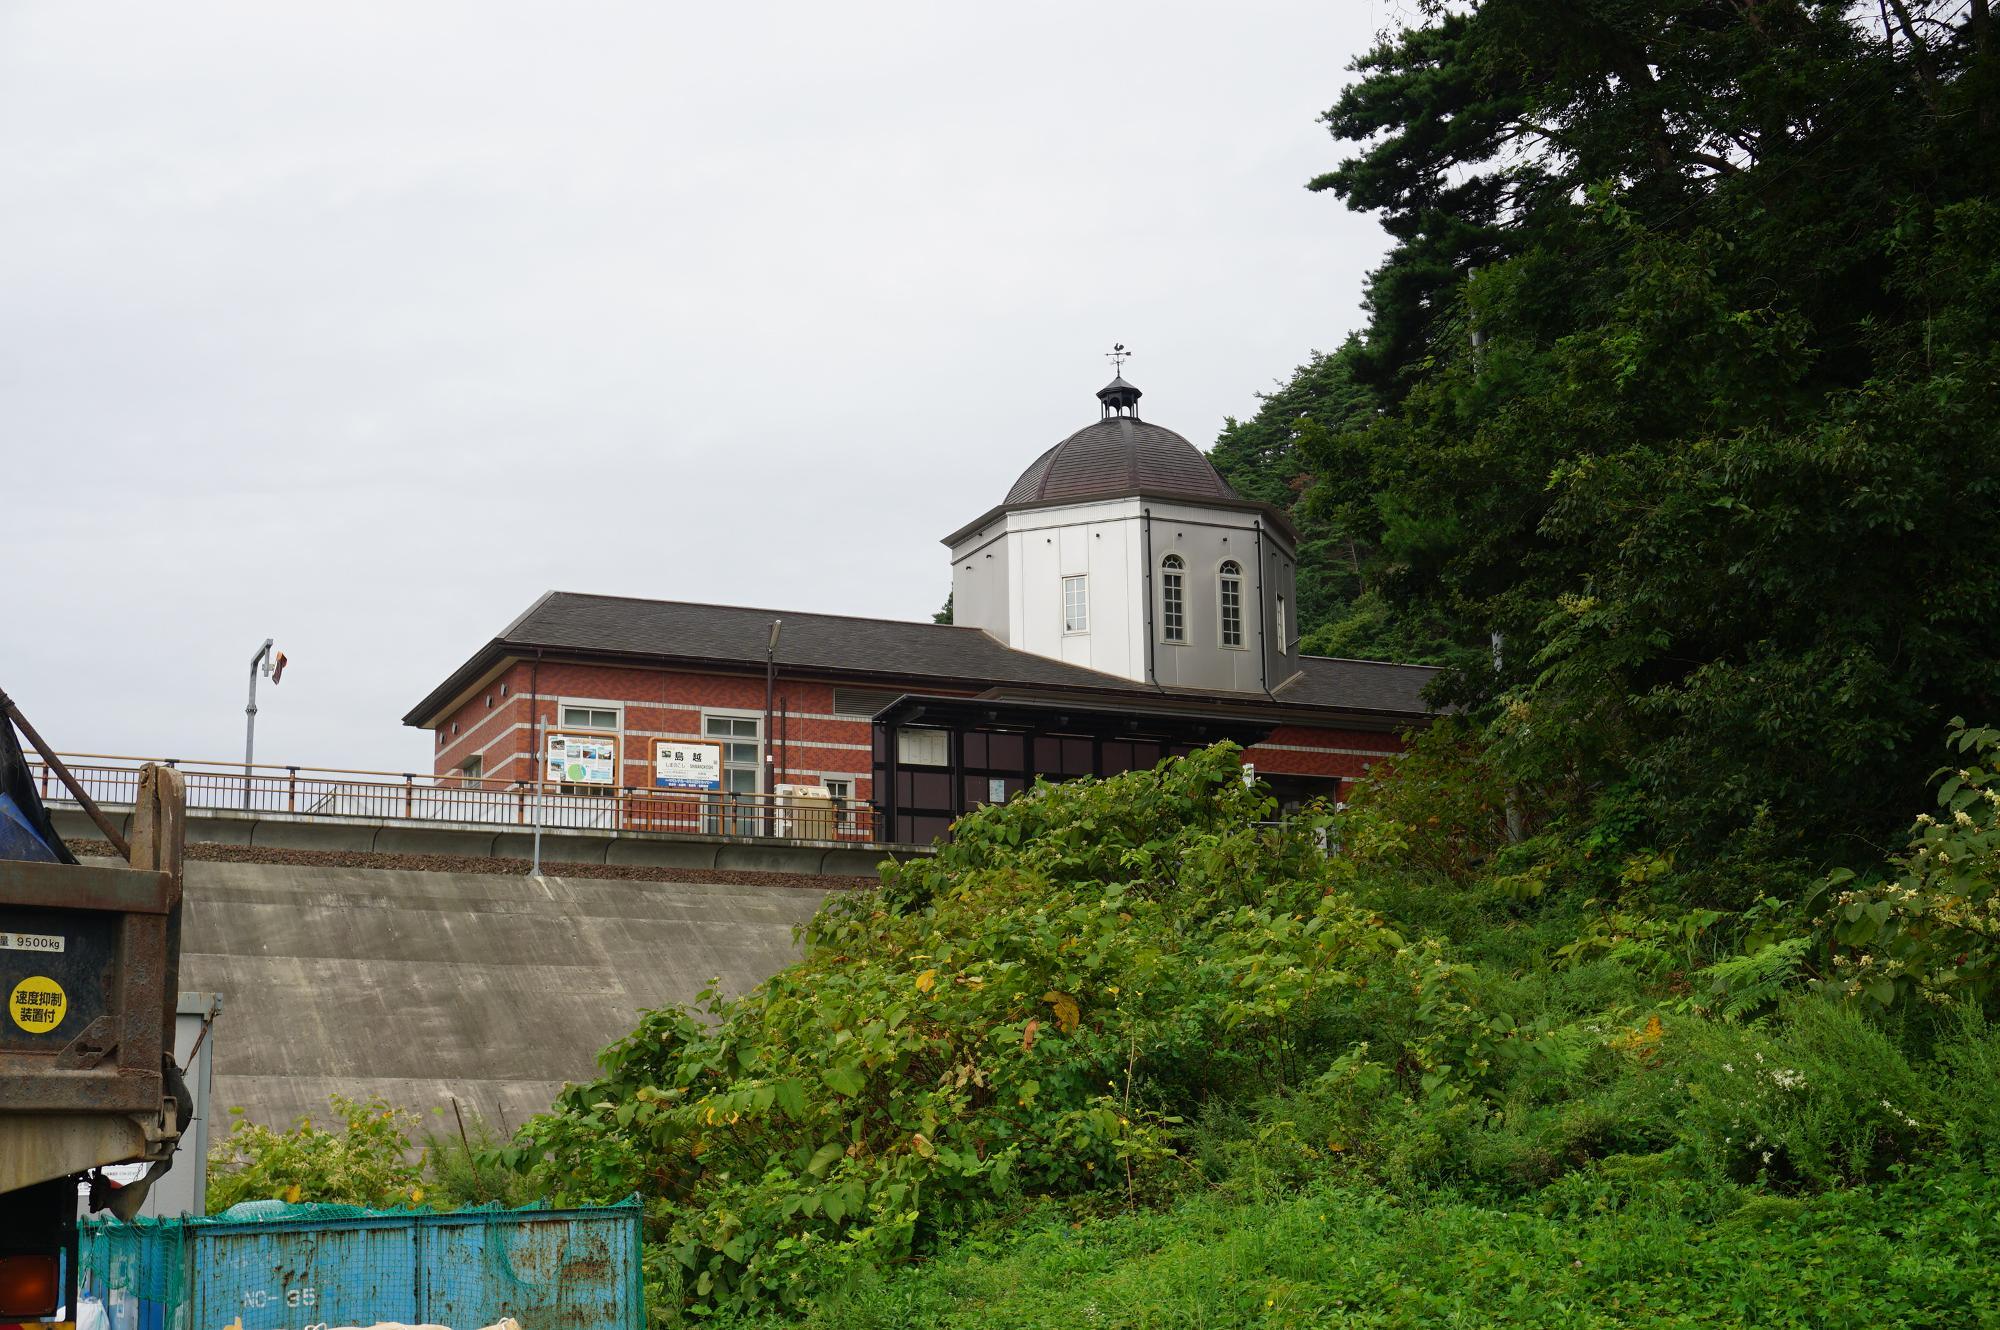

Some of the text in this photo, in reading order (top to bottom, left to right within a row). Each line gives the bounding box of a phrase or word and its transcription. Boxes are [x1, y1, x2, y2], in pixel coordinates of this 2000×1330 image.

[16, 937, 60, 949] 9500kg
[16, 990, 63, 1007] 速度抑制
[20, 1008, 56, 1023] 装置付
